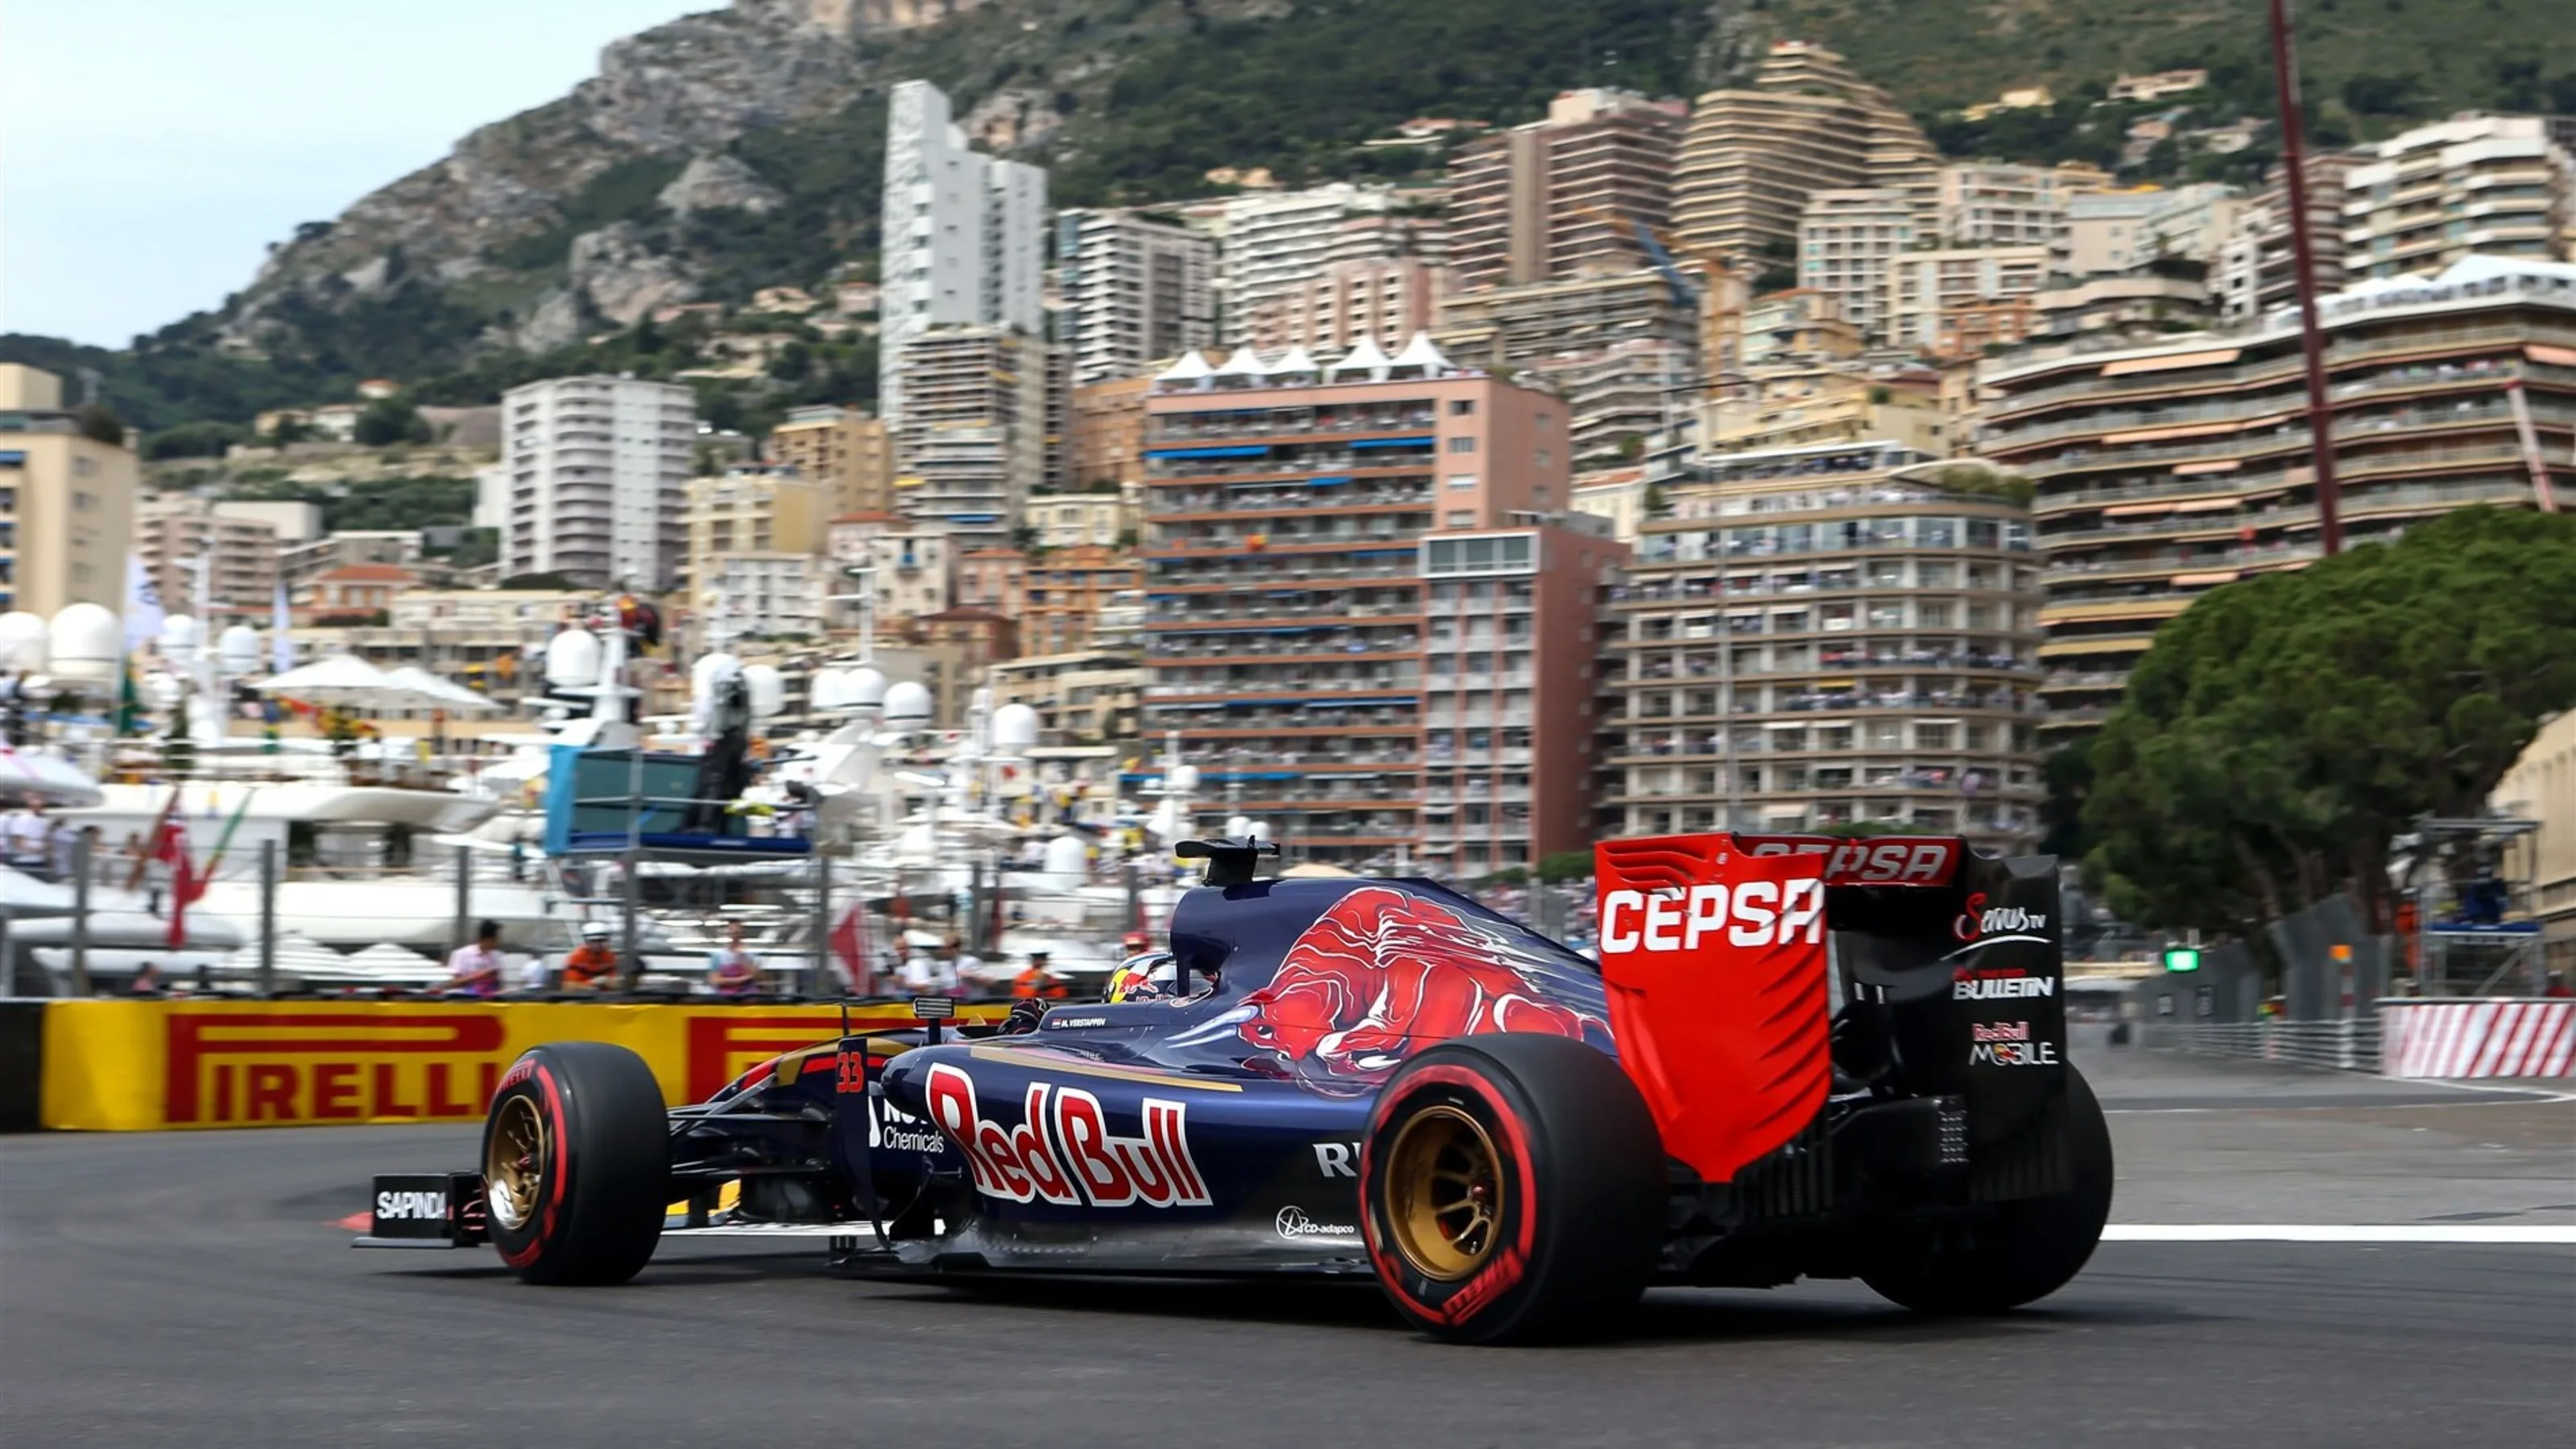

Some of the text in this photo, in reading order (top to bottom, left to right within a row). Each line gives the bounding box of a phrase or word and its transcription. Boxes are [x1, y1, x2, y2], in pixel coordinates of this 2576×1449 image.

[1601, 879, 1824, 953] CEPSA
[836, 1051, 865, 1093] 33
[883, 1125, 945, 1153] Chemicals
[926, 1062, 1081, 1205] Red
[1054, 1087, 1213, 1208] Bull
[376, 1191, 447, 1220] SAPINDA
[1304, 1223, 1354, 1235] CD-adapco
